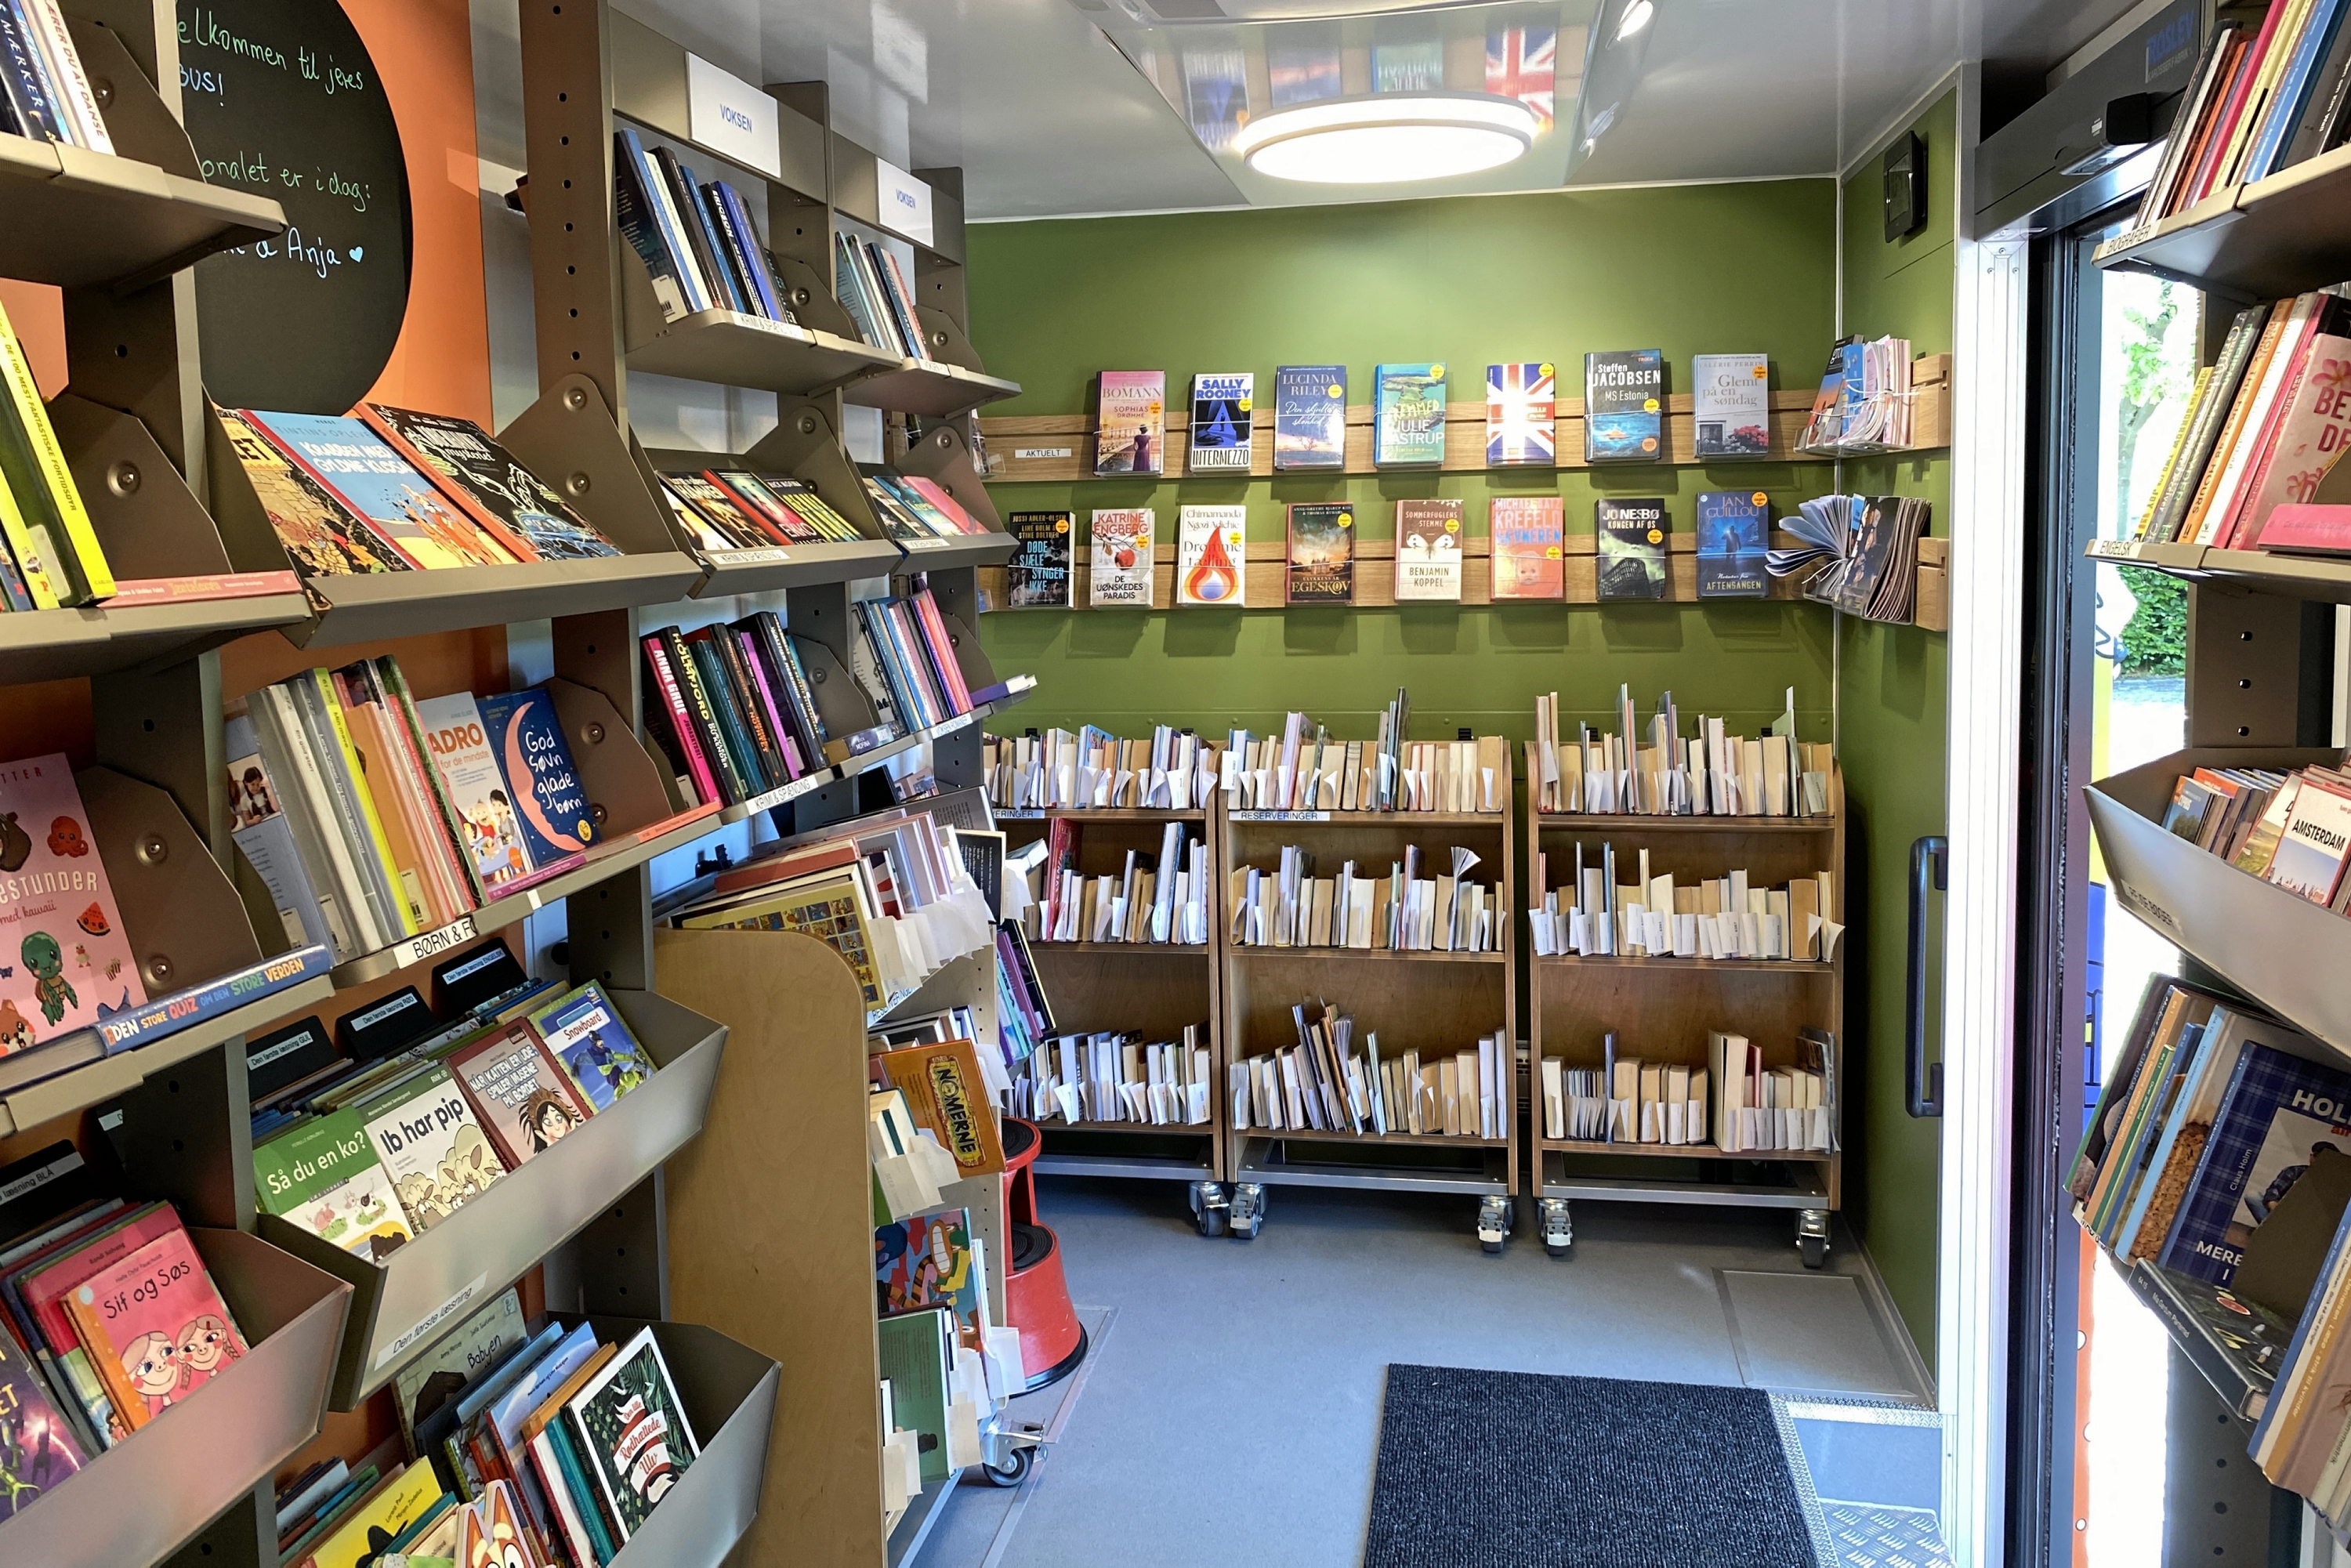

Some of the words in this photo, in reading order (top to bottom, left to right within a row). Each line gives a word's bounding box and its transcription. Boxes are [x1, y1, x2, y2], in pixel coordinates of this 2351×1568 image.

[1, 19, 43, 107] MÆRKER
[298, 46, 319, 80] til
[325, 55, 364, 95] jeres
[63, 47, 77, 69] DU
[74, 72, 85, 89] AT
[81, 91, 106, 139] DANSE
[720, 103, 752, 134] VOKSEN
[281, 170, 302, 186] er
[328, 172, 371, 212] dag:
[896, 188, 915, 209] VOKSEN
[2106, 225, 2152, 255] BIOGRAFIER
[288, 227, 341, 278] Anja
[1598, 364, 1628, 373] Steffen
[1202, 379, 1244, 389] SALLY
[1283, 374, 1337, 385] LUCINDA
[1592, 370, 1661, 386] JACOBSEN
[1718, 374, 1758, 388] Glemt
[2240, 370, 2255, 397] THE
[1103, 388, 1161, 398] BOMANN
[1196, 389, 1252, 399] ROONEY
[1291, 386, 1328, 396] RILEY
[1605, 391, 1617, 401] MS
[1619, 389, 1649, 400] Estonia
[1703, 386, 1717, 399] på
[1715, 393, 1758, 406] søndag
[19, 375, 31, 398] MEST
[28, 400, 55, 457] FANTASTISKE
[1286, 401, 1302, 415] Den
[1398, 419, 1431, 432] JULIE
[1193, 449, 1249, 465] INTERMEZZO
[2162, 454, 2173, 472] TWO
[674, 483, 729, 499] HAMMER
[2191, 463, 2216, 515] HOURS
[1496, 498, 1534, 509] MICHAEL
[1722, 496, 1744, 508] JAN
[2146, 488, 2159, 509] JOY
[1098, 512, 1145, 524] KATRINE
[1186, 509, 1241, 518] Chimamanda
[1495, 510, 1560, 528] KREFELD
[1603, 509, 1618, 520] JO
[1620, 509, 1660, 520] NESBØ
[1706, 506, 1759, 518] GUILLOU
[779, 523, 817, 538] EKKO
[1094, 523, 1149, 534] ENGBERG
[1187, 521, 1208, 530] Ngozi
[1211, 520, 1240, 529] Adichie
[1636, 520, 1644, 529] AF
[1027, 541, 1048, 553] DØDE
[1184, 541, 1241, 552] Drømme
[2099, 541, 2132, 556] ENGELSK
[1020, 554, 1044, 567] SJÆLE
[1032, 567, 1064, 580] SYNGER
[1029, 581, 1047, 592] IKKE
[1096, 583, 1143, 592] UØNSKEDES
[1291, 581, 1351, 595] EGESKOV
[1414, 578, 1444, 587] KOPPEL
[1706, 581, 1762, 591] AFTENSANGEN
[653, 647, 675, 683] ANNA
[666, 682, 687, 715] GRUE
[331, 711, 342, 725] Min
[295, 729, 302, 739] En
[336, 726, 350, 748] mave
[526, 727, 556, 752] God
[297, 740, 308, 755] god
[303, 755, 315, 773] start
[440, 758, 453, 770] for
[453, 757, 463, 766] de
[464, 750, 490, 764] mindste
[538, 770, 574, 809] glade
[755, 793, 773, 810] KRIMI
[773, 791, 779, 802] &
[777, 779, 810, 801] SPÆNDING
[422, 800, 433, 817] barn
[553, 797, 581, 814] børn
[1240, 811, 1318, 820] RESERVERINGER
[2291, 819, 2346, 851] AMSTERDAM
[23, 901, 57, 920] kawaii
[413, 930, 451, 958] BØRN
[452, 926, 462, 942] &
[484, 950, 505, 963] ENGELSK
[113, 1019, 139, 1041] DEN
[141, 1011, 168, 1029] STORE
[168, 998, 198, 1019] QUIZ
[200, 996, 212, 1007] OM
[213, 989, 230, 1002] DEN
[230, 972, 265, 996] STORE
[264, 958, 304, 983] VERDEN
[563, 1012, 602, 1041] Snowboard
[252, 1056, 263, 1066] Den
[279, 1040, 300, 1056] læsning
[299, 1034, 311, 1045] GUL
[469, 1073, 486, 1093] NÅR
[485, 1059, 512, 1083] KATTEN
[508, 1051, 523, 1066] ER
[486, 1078, 513, 1100] SPILLER
[511, 1061, 539, 1084] MUSENE
[501, 1092, 515, 1110] PÅ
[511, 1079, 541, 1102] BORDET
[2146, 1081, 2155, 1095] Over
[2224, 1081, 2236, 1101] Claus
[2139, 1095, 2149, 1110] åben
[380, 1129, 403, 1155] Ib
[399, 1112, 433, 1144] har
[435, 1097, 464, 1131] pip
[267, 1168, 292, 1194] Så
[293, 1160, 316, 1182] du
[317, 1151, 339, 1170] en
[337, 1132, 366, 1159] ko?
[2230, 1168, 2244, 1192] Claus
[2240, 1148, 2253, 1169] Holm
[3, 1178, 36, 1198] læsning
[36, 1164, 54, 1182] BLÅ
[103, 1291, 128, 1319] Sif
[133, 1278, 158, 1302] og
[158, 1261, 190, 1287] Søs
[393, 1334, 411, 1354] Den
[413, 1314, 438, 1338] første
[440, 1287, 473, 1319] læsning
[2320, 1324, 2334, 1349] Læsø
[466, 1334, 502, 1369] Babyen
[2309, 1354, 2321, 1374] strik
[2291, 1385, 2309, 1418] kvinder
[639, 1453, 658, 1476] Ulv
